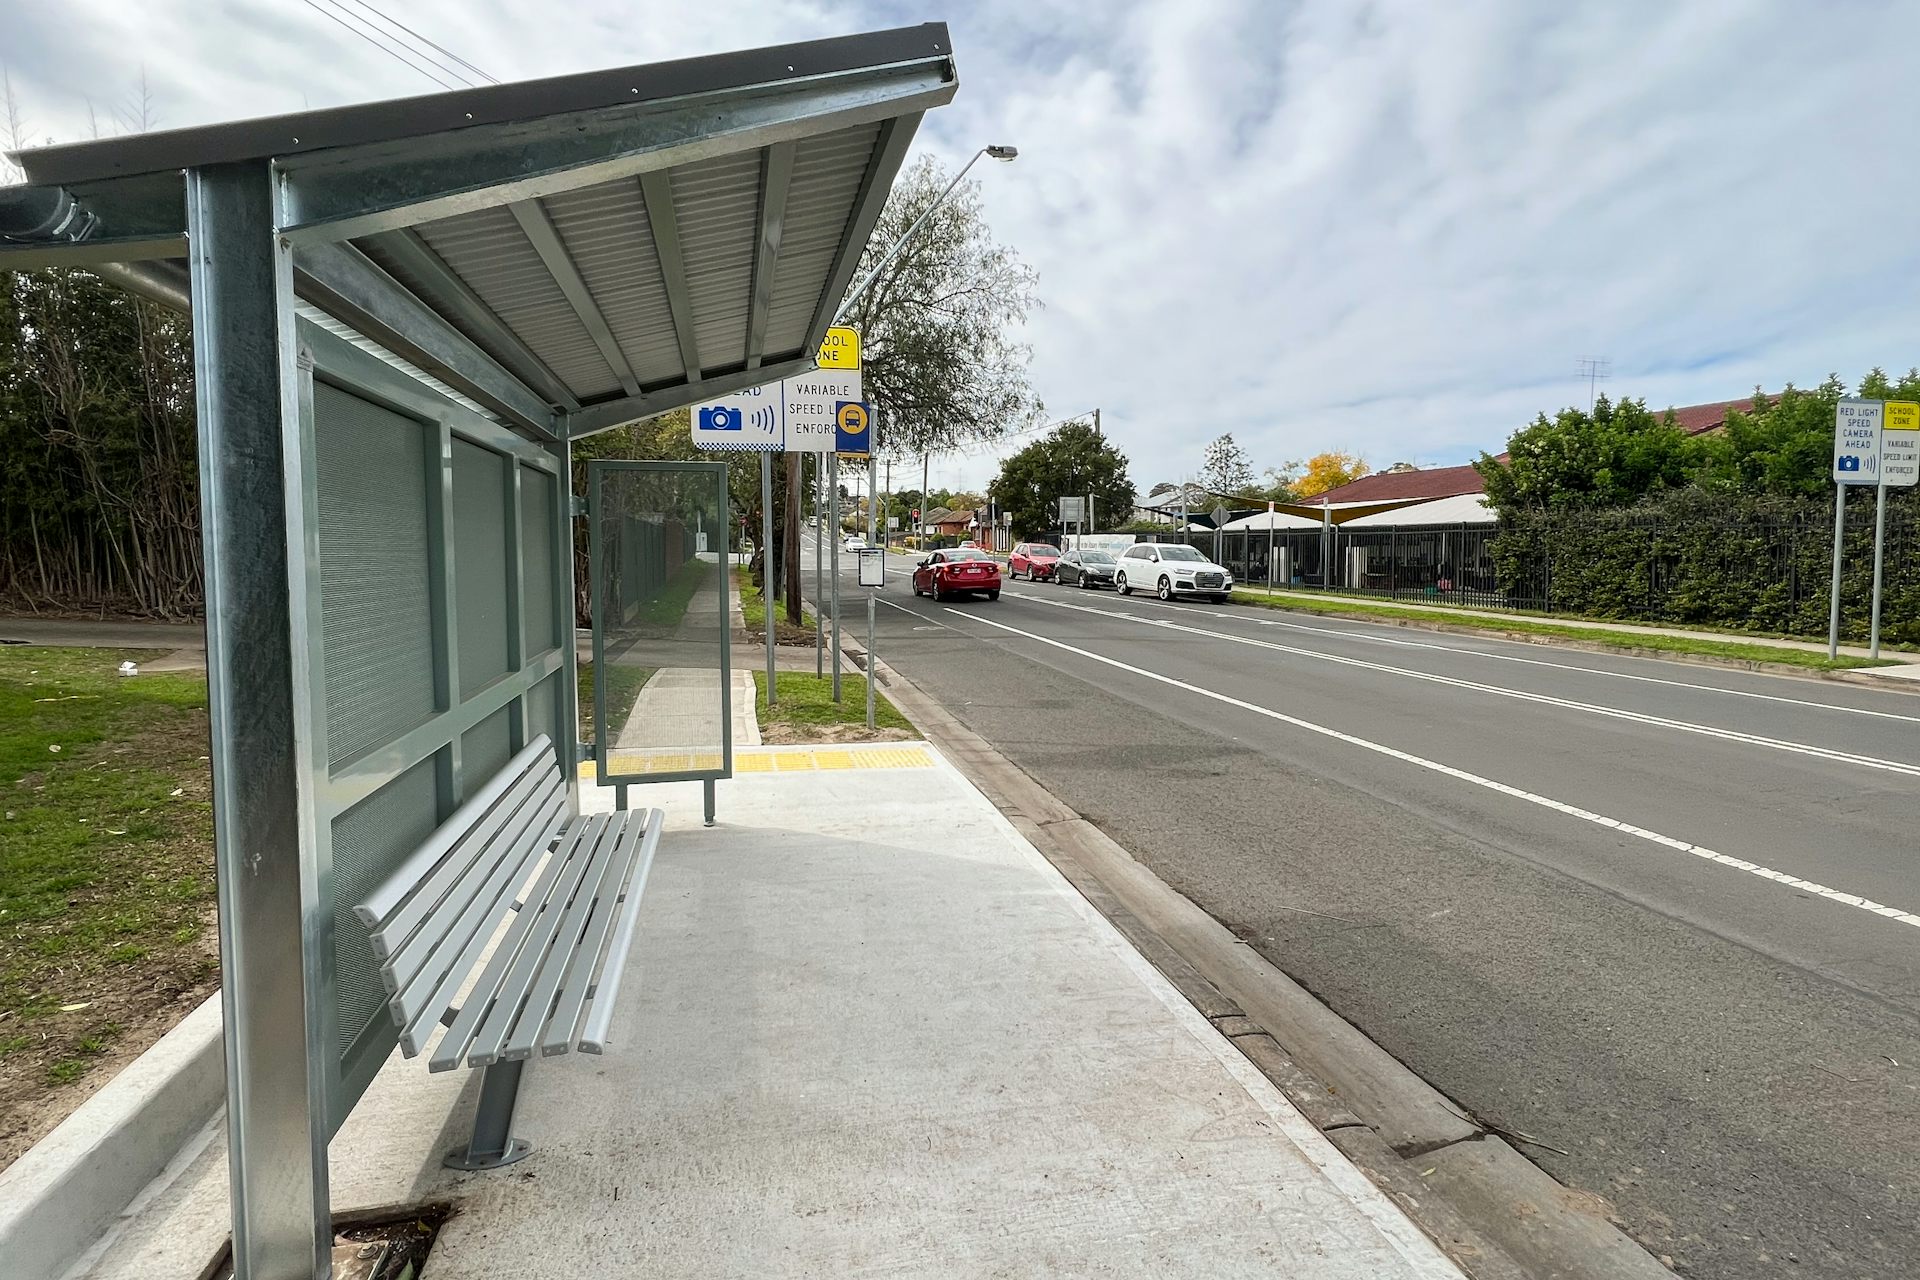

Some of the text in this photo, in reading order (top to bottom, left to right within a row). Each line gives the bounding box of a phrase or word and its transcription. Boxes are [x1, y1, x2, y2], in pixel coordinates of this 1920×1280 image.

[823, 335, 848, 346] OOL
[796, 384, 849, 396] VARIABLE
[789, 403, 823, 415] SPEED
[1840, 407, 1879, 417] RED LIGHT
[1888, 407, 1915, 416] SCHOOL
[1847, 418, 1871, 427] SPEED
[1893, 417, 1911, 425] ZONE
[796, 423, 836, 434] ENFORC
[1843, 429, 1874, 438] CAMERA
[1845, 440, 1871, 448] AHEAD
[1887, 440, 1915, 448] VARIABLE
[1883, 453, 1917, 461] SPEED LIMIT
[1885, 466, 1914, 474] ENFORCED
